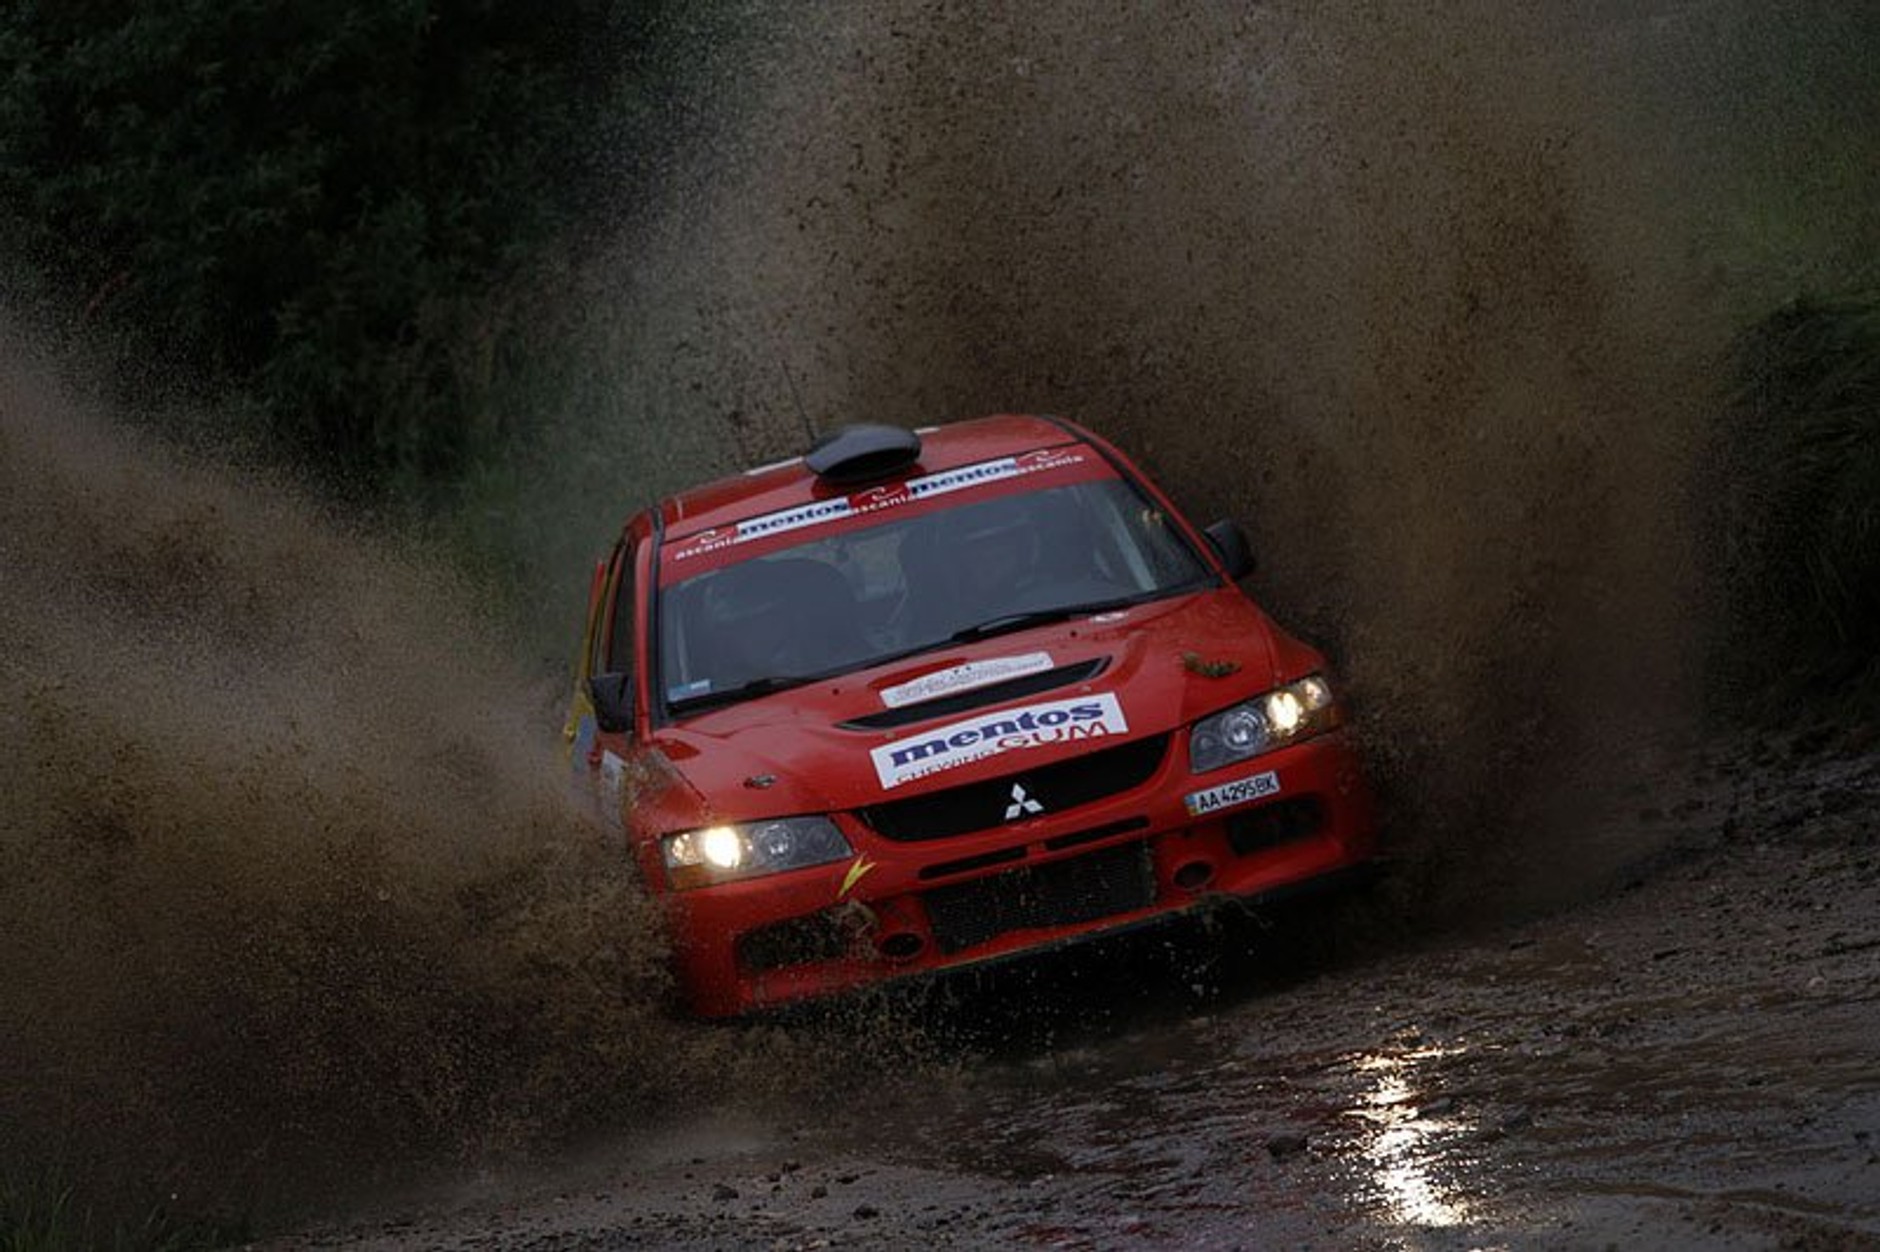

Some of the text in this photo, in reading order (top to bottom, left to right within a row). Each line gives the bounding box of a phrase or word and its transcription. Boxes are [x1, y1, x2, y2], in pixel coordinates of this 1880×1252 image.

[740, 502, 849, 535] mentos
[911, 462, 1016, 495] mentos
[890, 702, 1103, 767] mentos
[997, 721, 1109, 747] GUM
